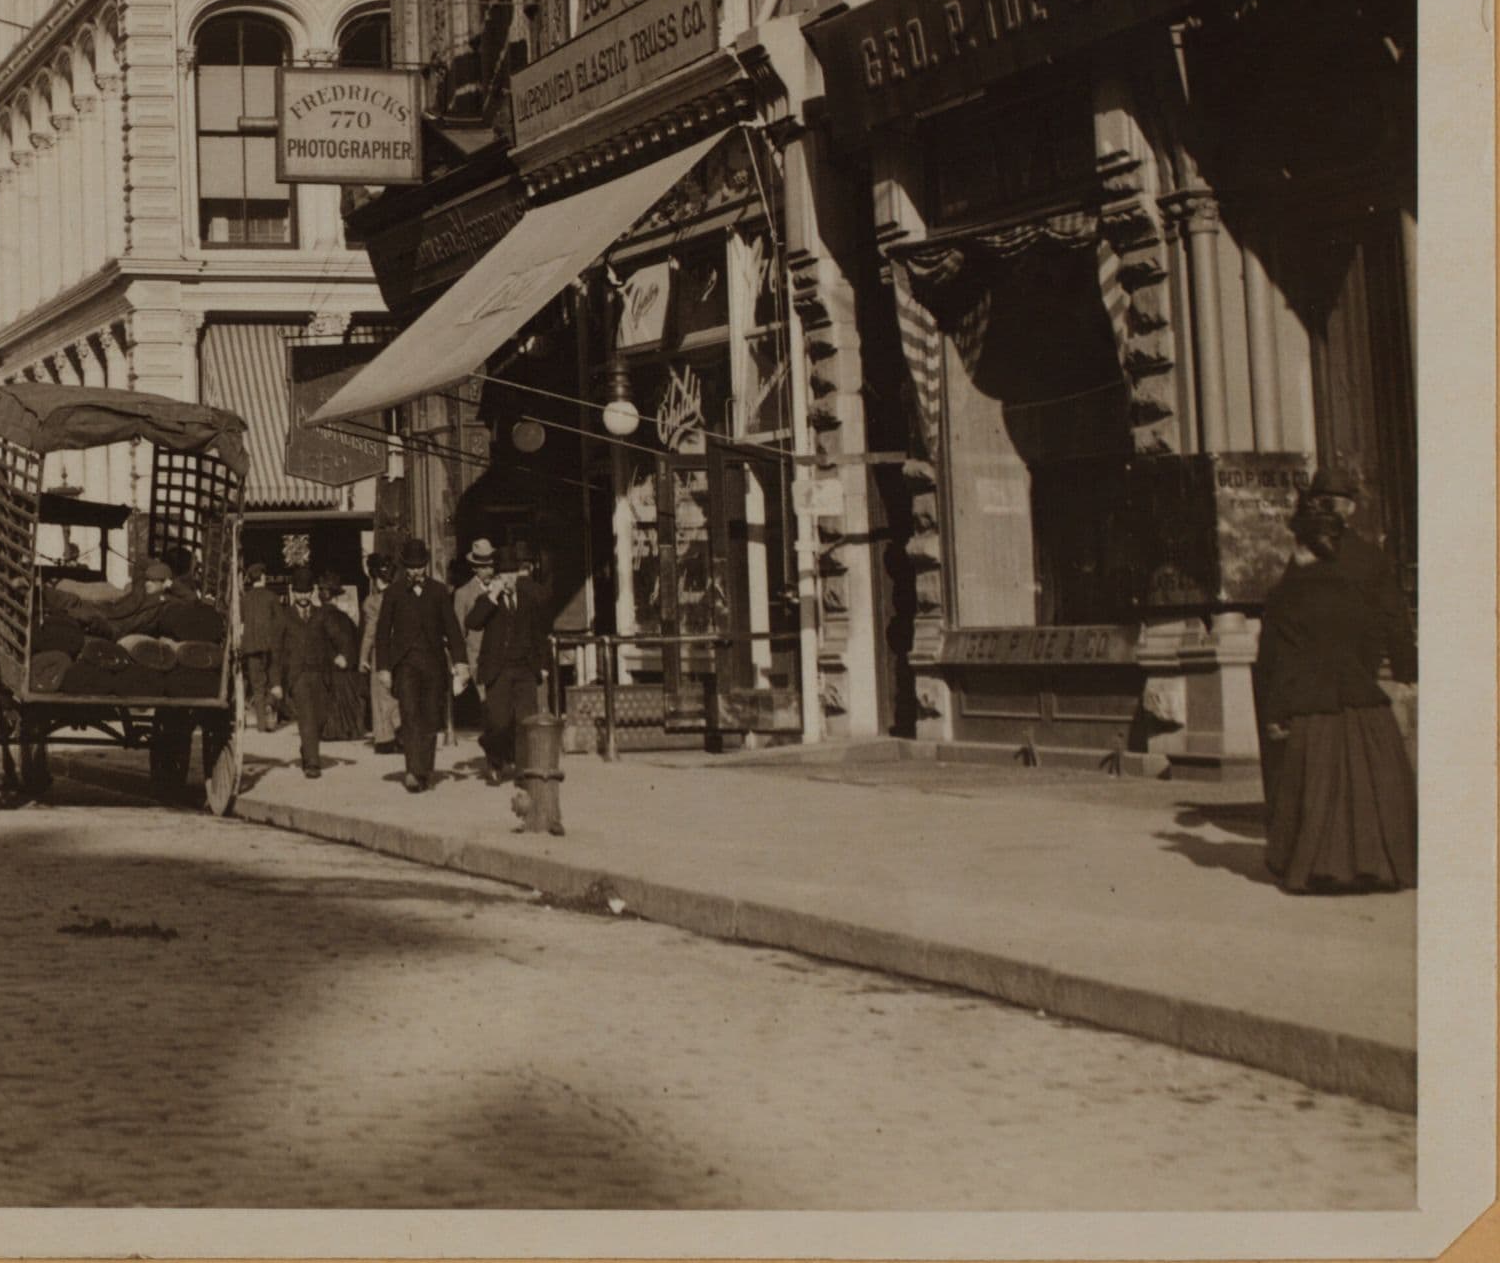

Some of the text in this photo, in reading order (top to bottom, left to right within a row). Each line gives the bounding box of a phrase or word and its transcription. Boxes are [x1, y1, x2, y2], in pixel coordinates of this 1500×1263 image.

[578, 39, 628, 92] ELASTIC
[629, 13, 678, 66] TRUSS
[681, 2, 708, 38] CO.
[859, 17, 939, 88] GEO.
[329, 110, 371, 129] 770
